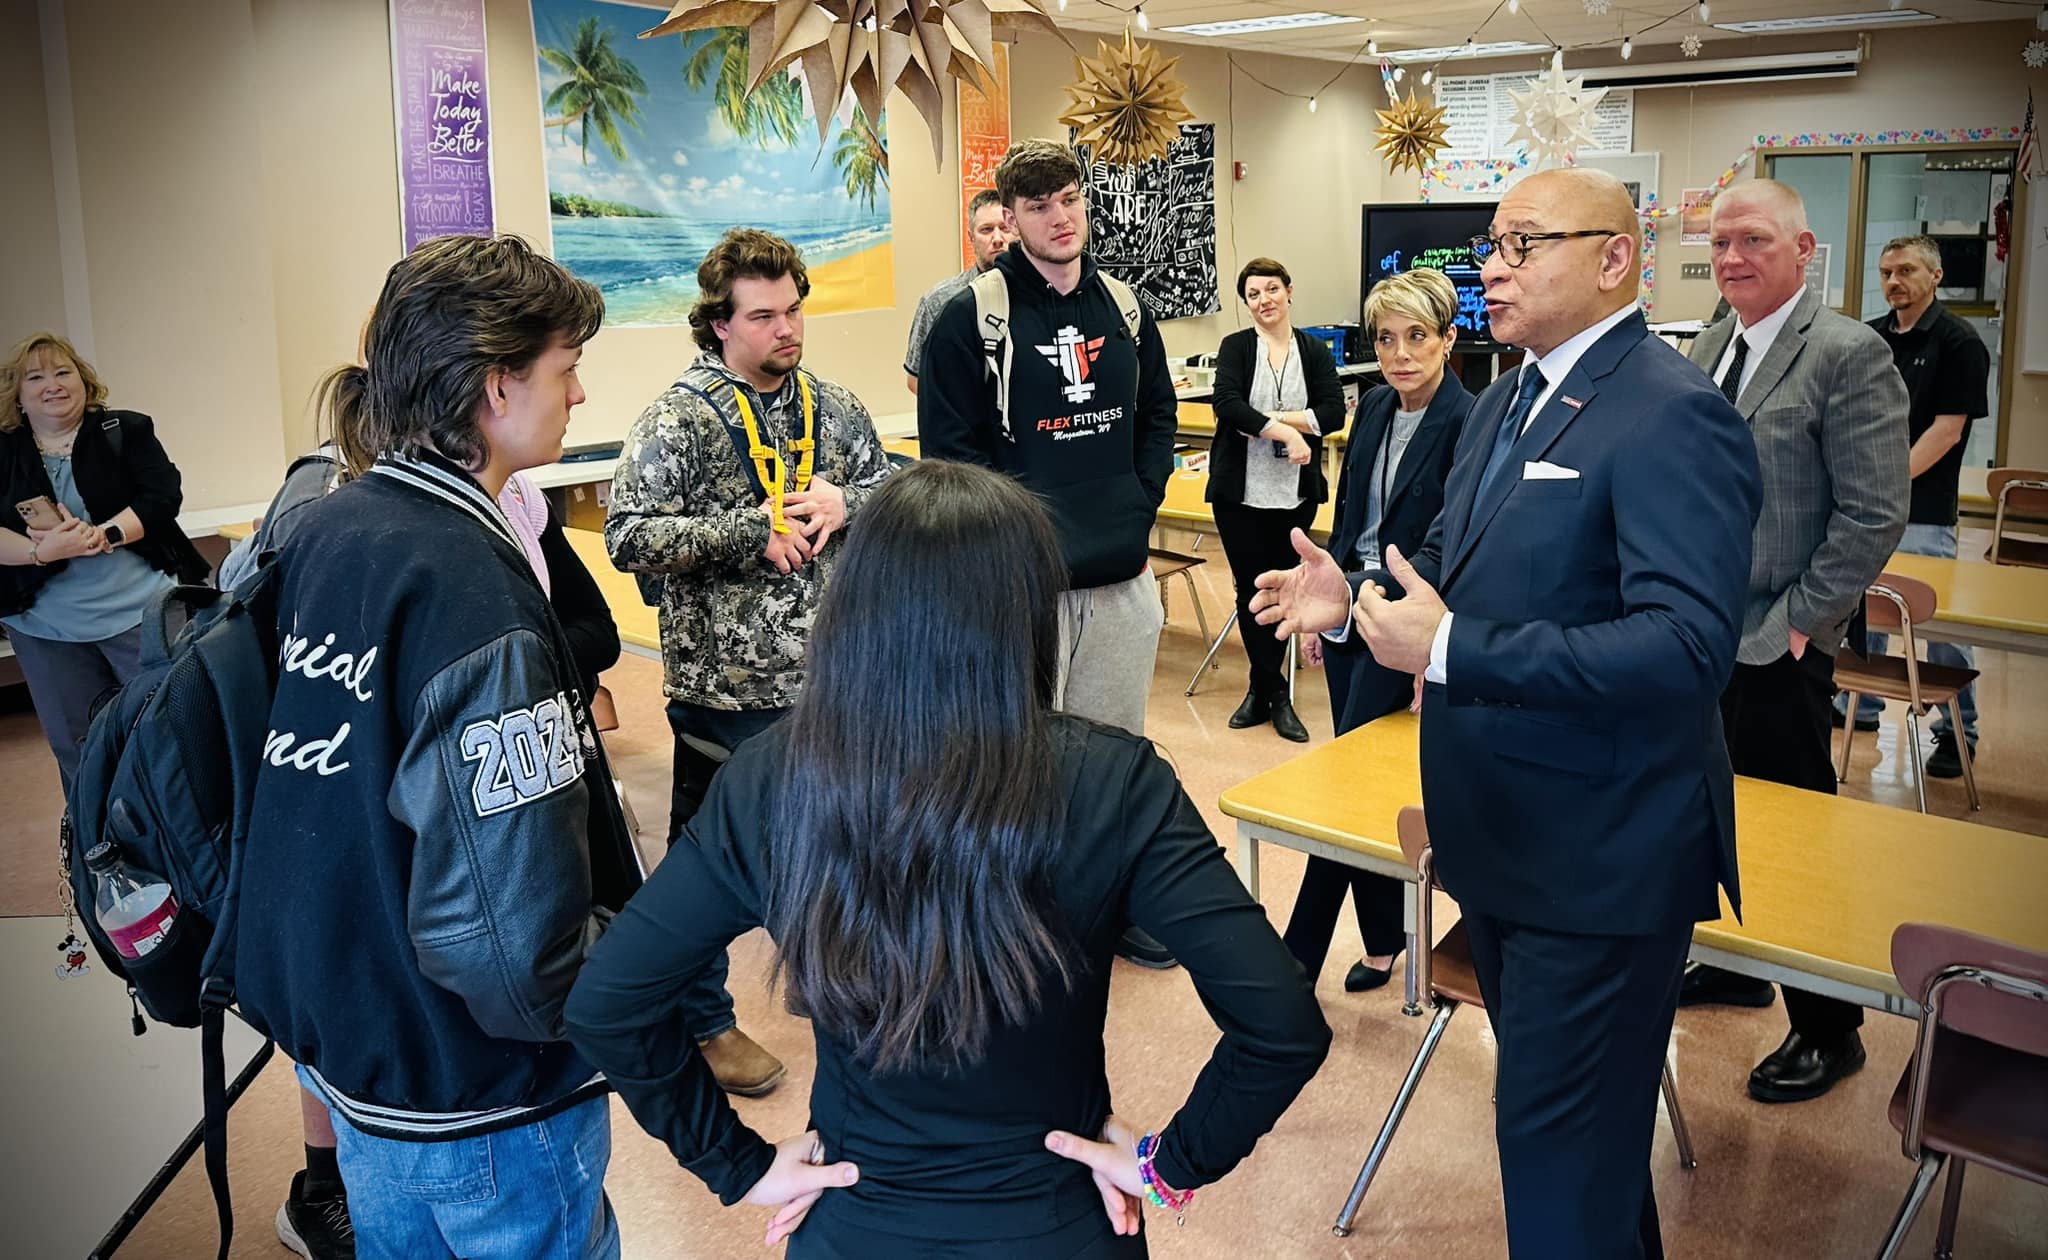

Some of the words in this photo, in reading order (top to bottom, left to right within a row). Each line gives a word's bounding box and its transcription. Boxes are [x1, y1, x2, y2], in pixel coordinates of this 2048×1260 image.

[430, 67, 482, 99] Make
[428, 92, 483, 134] Today
[427, 122, 485, 156] Better
[432, 163, 484, 181] BREATHE
[1112, 194, 1147, 225] ARE
[1037, 416, 1071, 431] FLEX
[1073, 406, 1123, 426] FITNESS
[263, 722, 351, 776] nd
